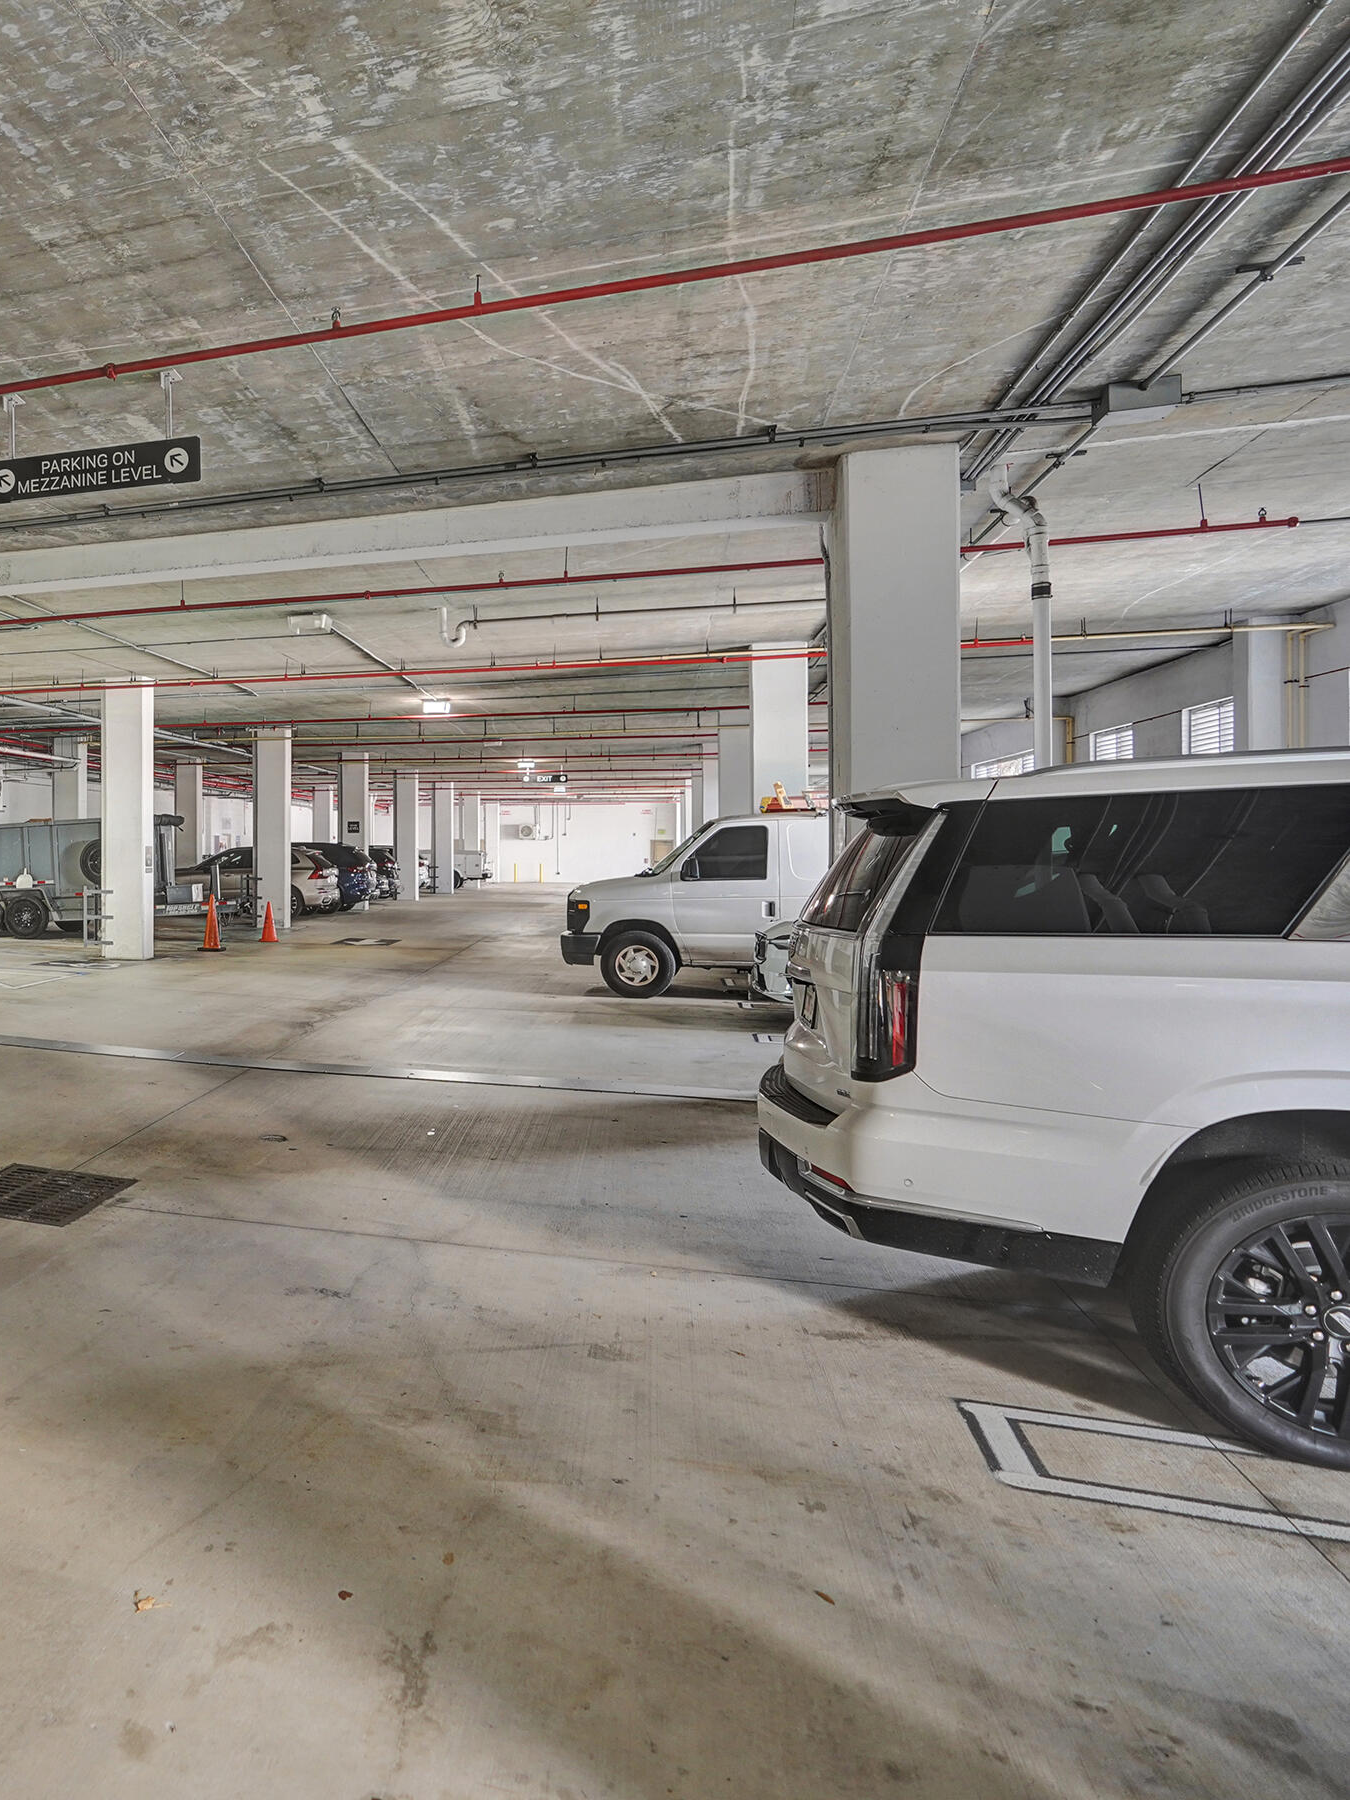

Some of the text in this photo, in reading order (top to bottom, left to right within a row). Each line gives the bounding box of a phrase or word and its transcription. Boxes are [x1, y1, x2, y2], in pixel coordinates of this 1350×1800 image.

[41, 450, 135, 475] PARKING ON
[17, 464, 162, 494] MEZZANINE LEVEL
[536, 775, 553, 783] EXIT
[1231, 1185, 1329, 1223] BRIDGESTONE
